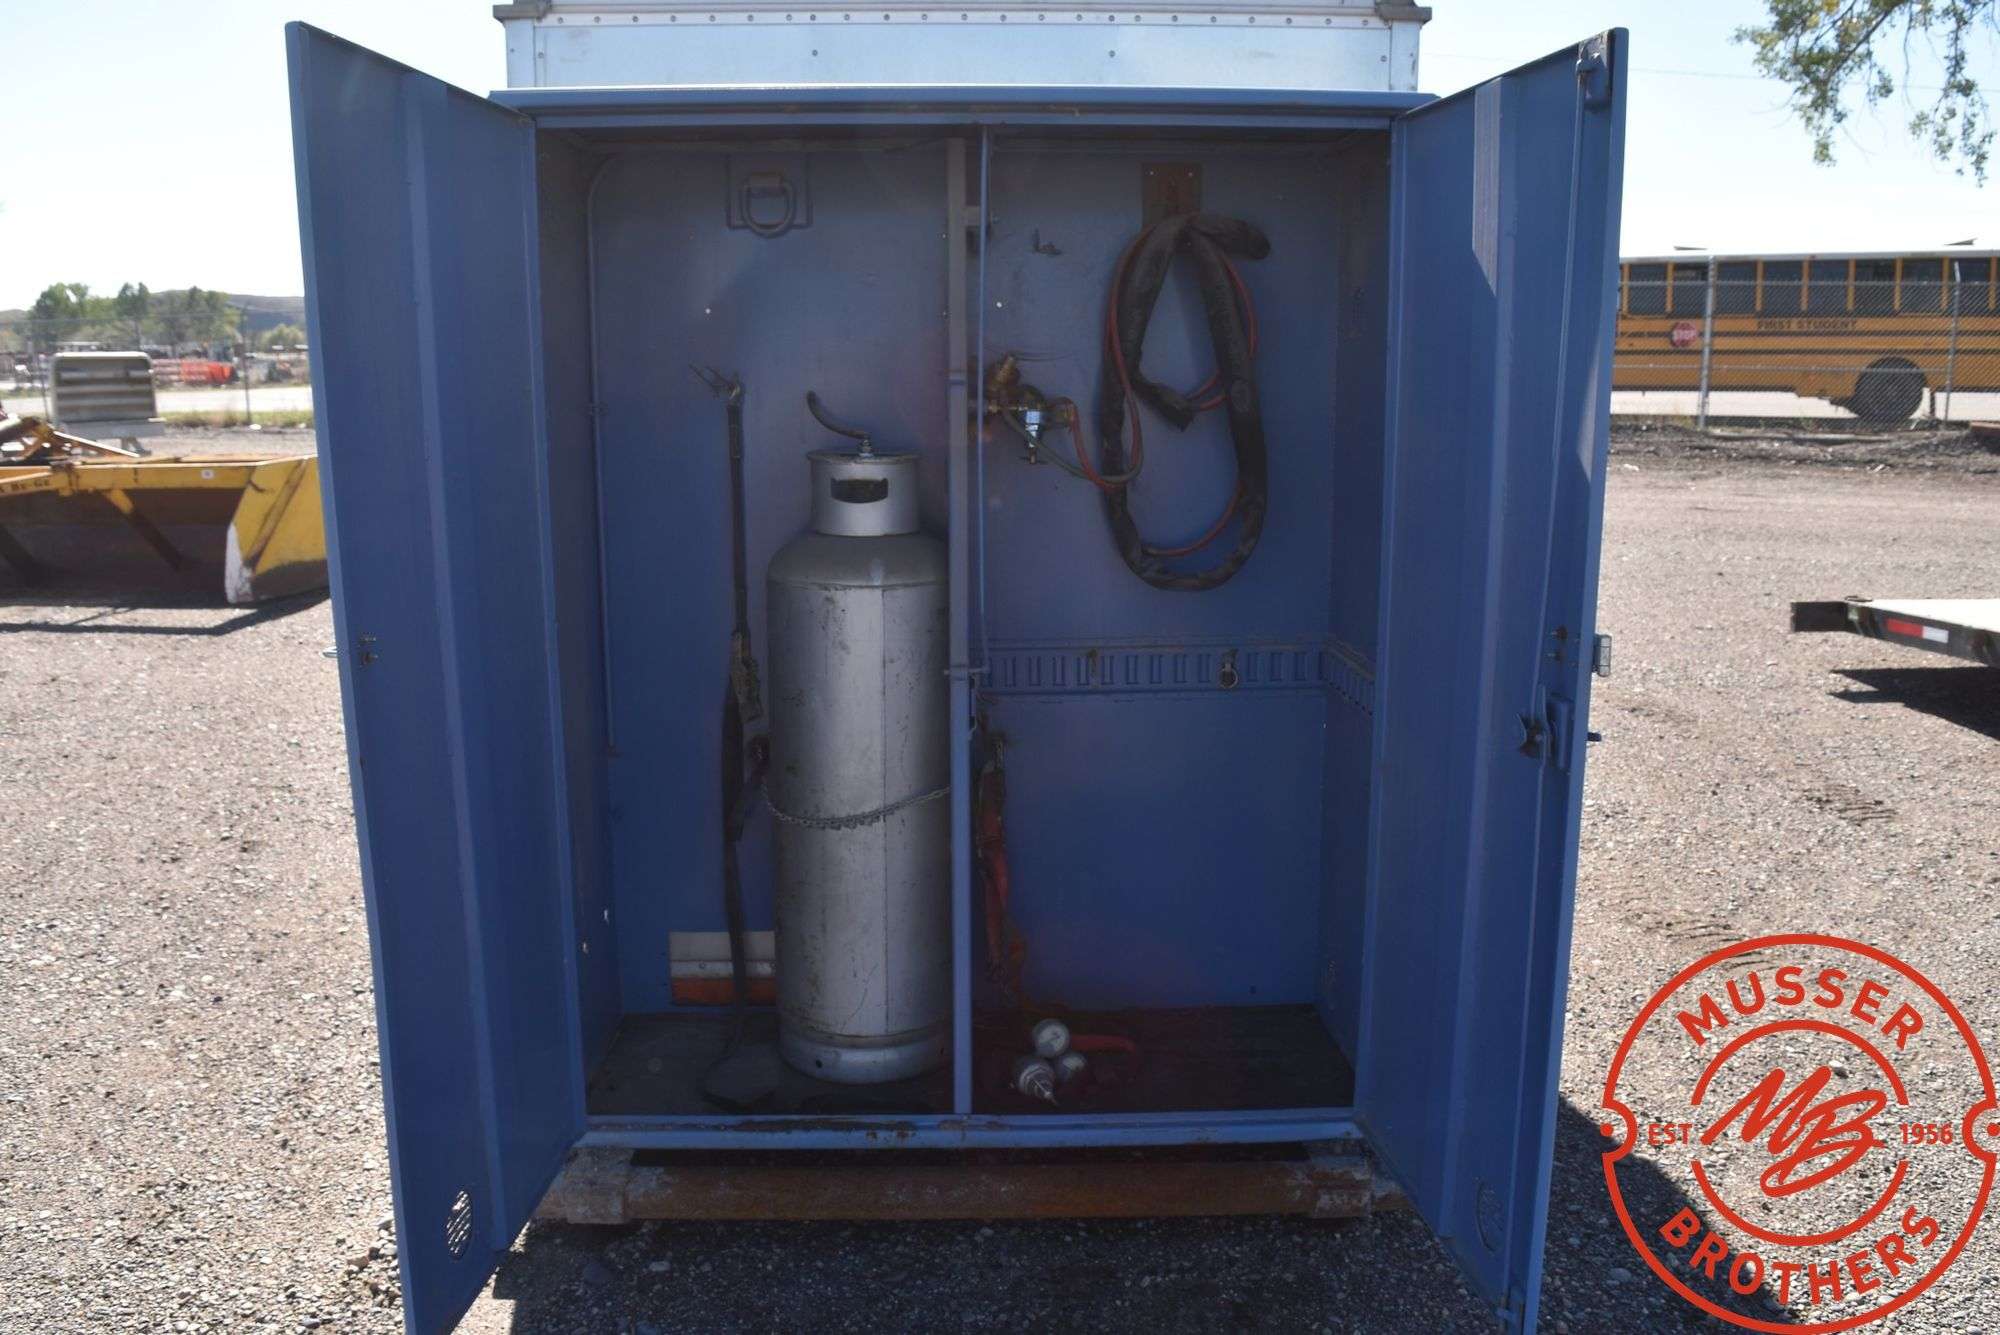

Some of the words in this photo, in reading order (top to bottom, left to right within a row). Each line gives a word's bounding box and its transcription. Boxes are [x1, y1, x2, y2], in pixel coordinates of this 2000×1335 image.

[1757, 319, 1792, 331] FIRST
[1797, 319, 1857, 331] STUDENT
[1672, 329, 1698, 341] STOP
